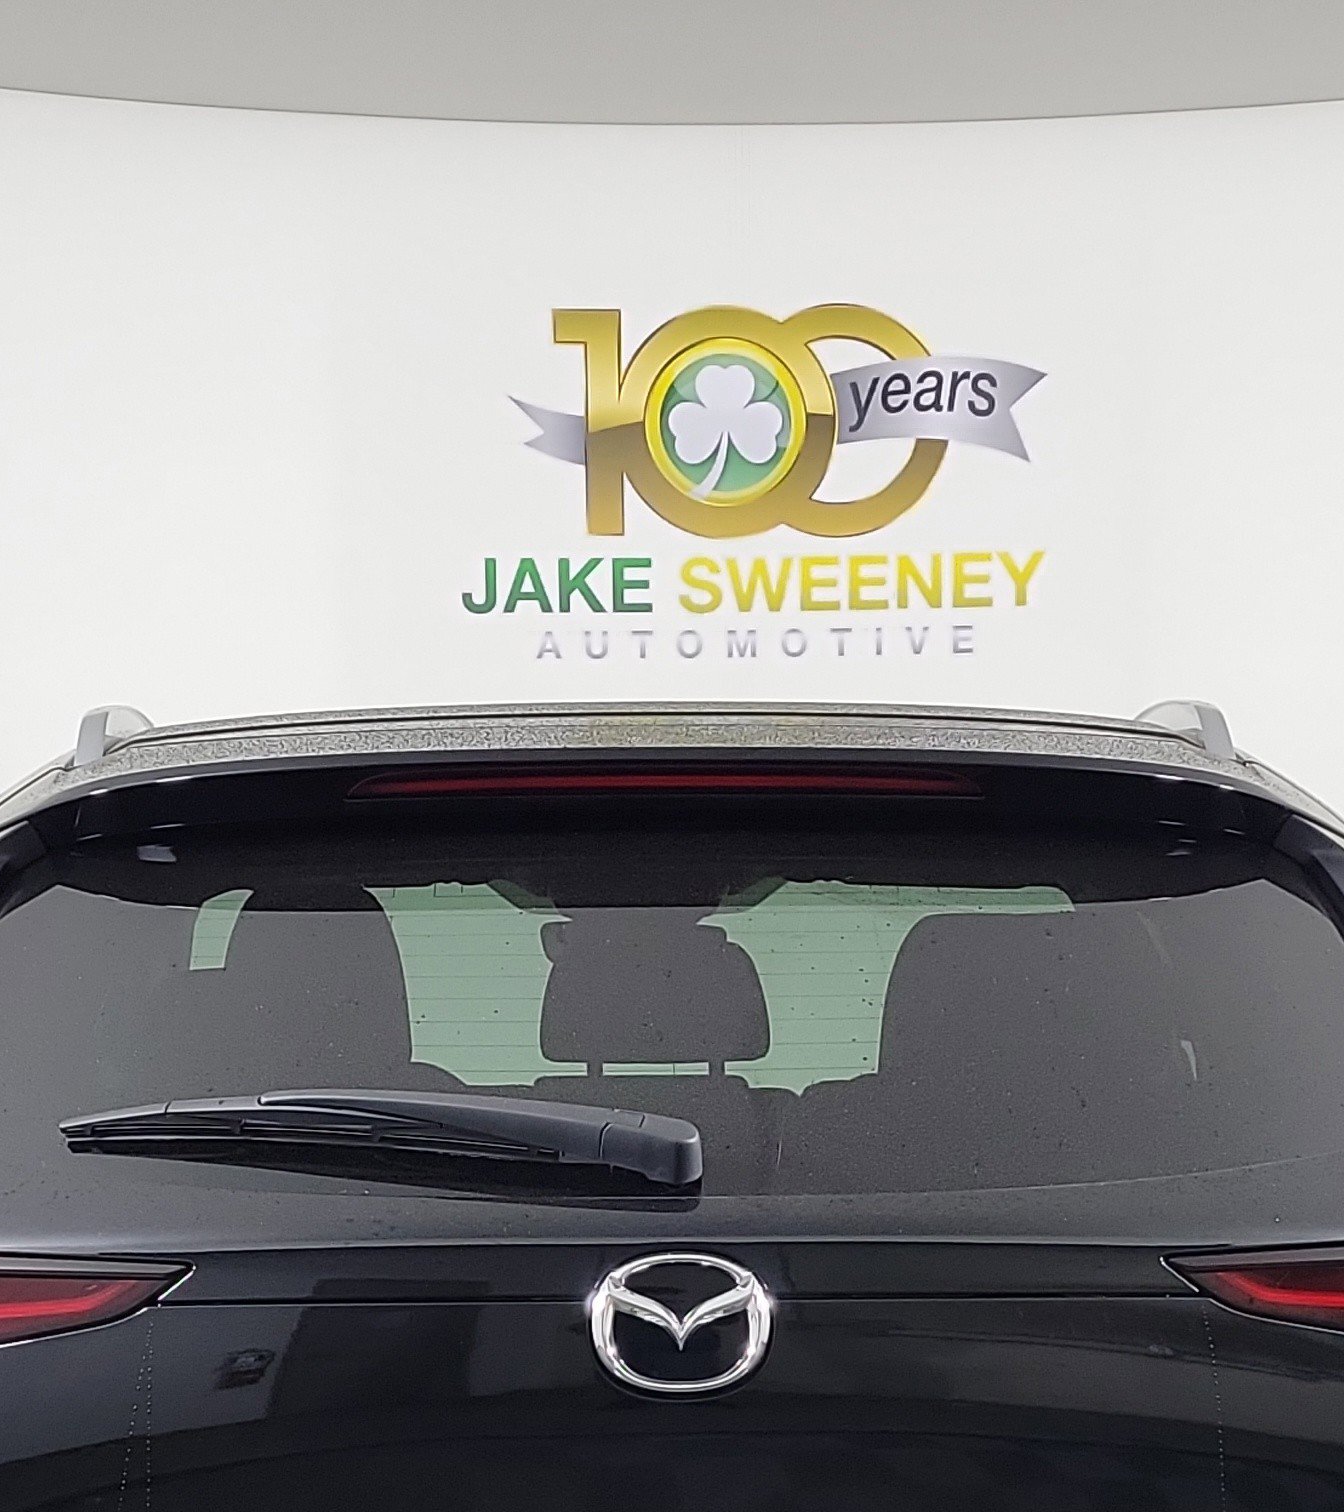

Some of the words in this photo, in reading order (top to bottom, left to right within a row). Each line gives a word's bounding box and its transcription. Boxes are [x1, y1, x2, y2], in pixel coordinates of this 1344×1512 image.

[551, 302, 951, 539] 100
[848, 367, 999, 432] years
[461, 556, 653, 614] JAKE
[678, 550, 1045, 613] SWEENEY
[536, 624, 975, 660] AUTOMOTIVE
